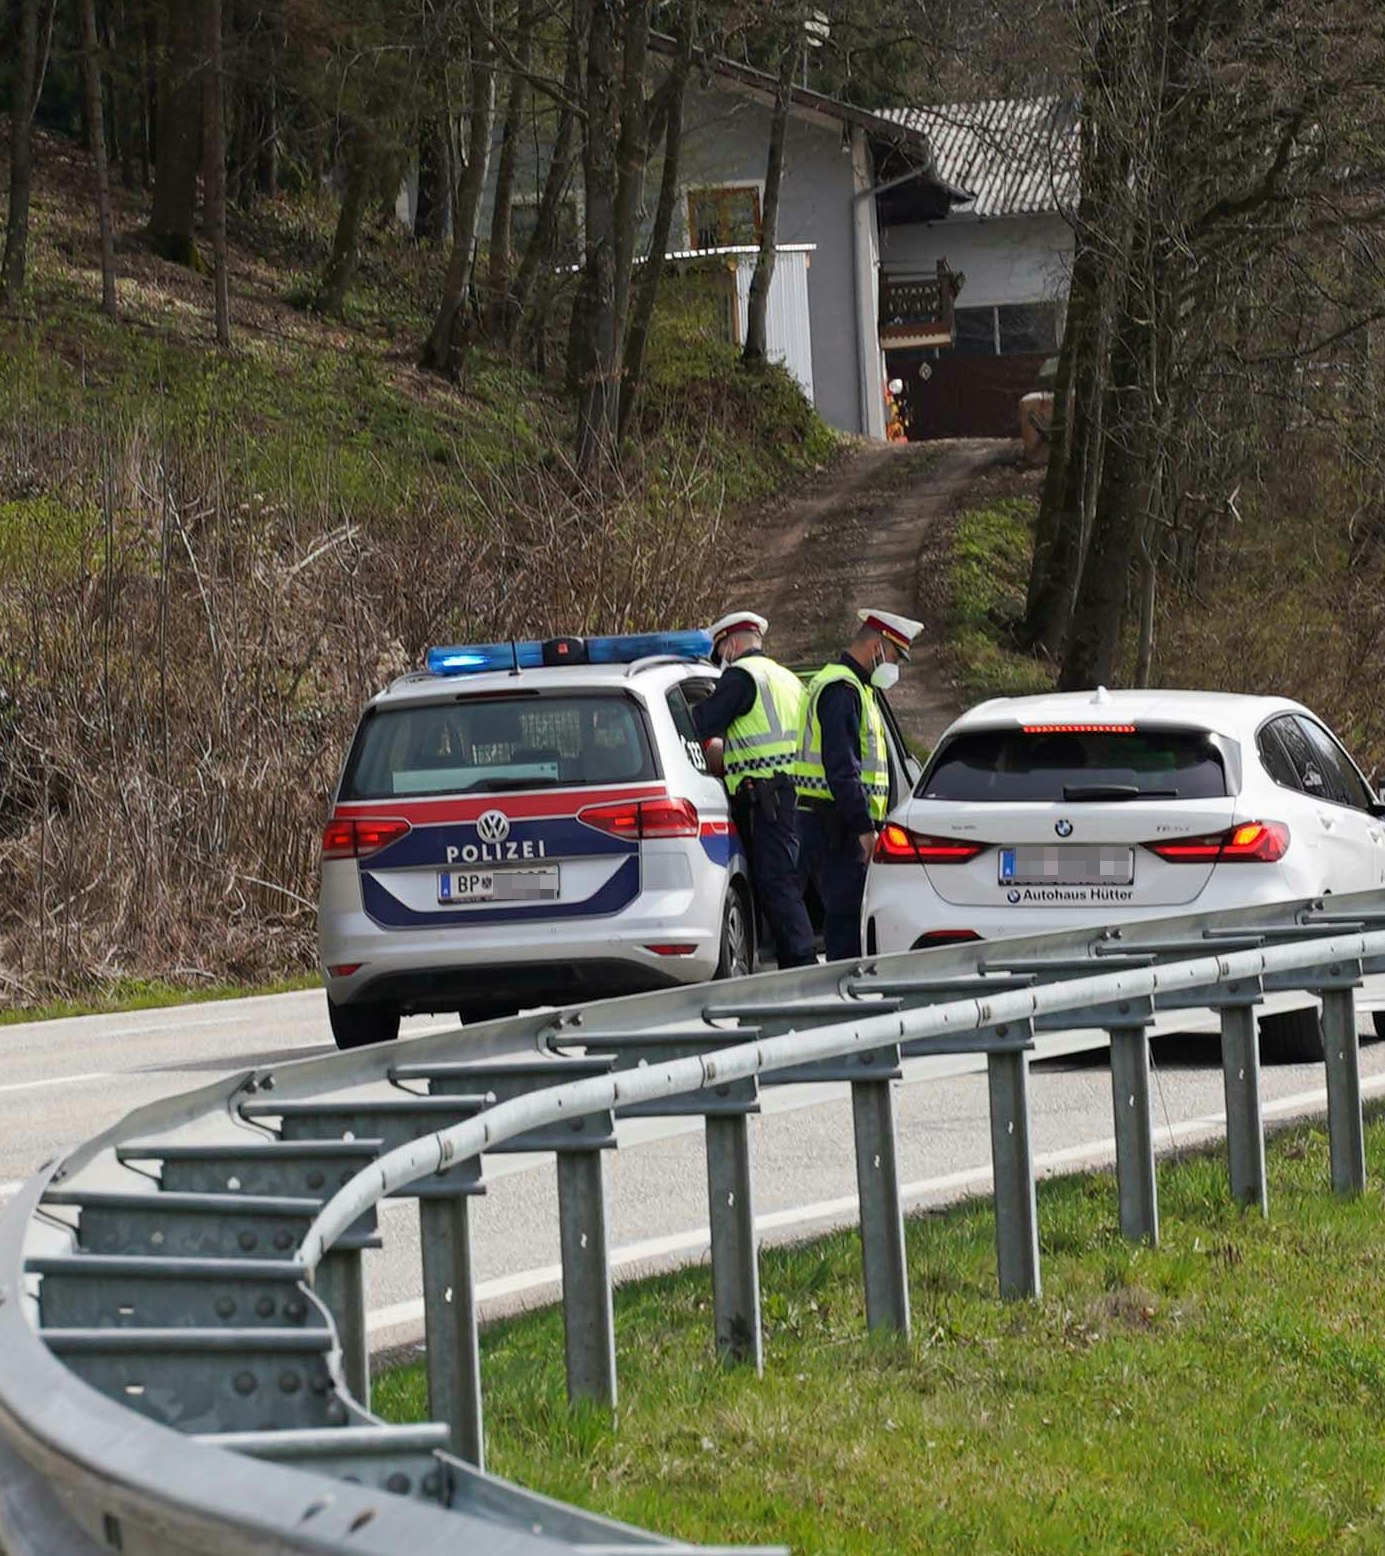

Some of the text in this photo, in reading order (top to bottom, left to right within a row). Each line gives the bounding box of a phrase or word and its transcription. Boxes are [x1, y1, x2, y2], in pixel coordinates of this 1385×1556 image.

[446, 839, 546, 863] POLIZEI
[1023, 889, 1133, 900] Autohaus Hütter
